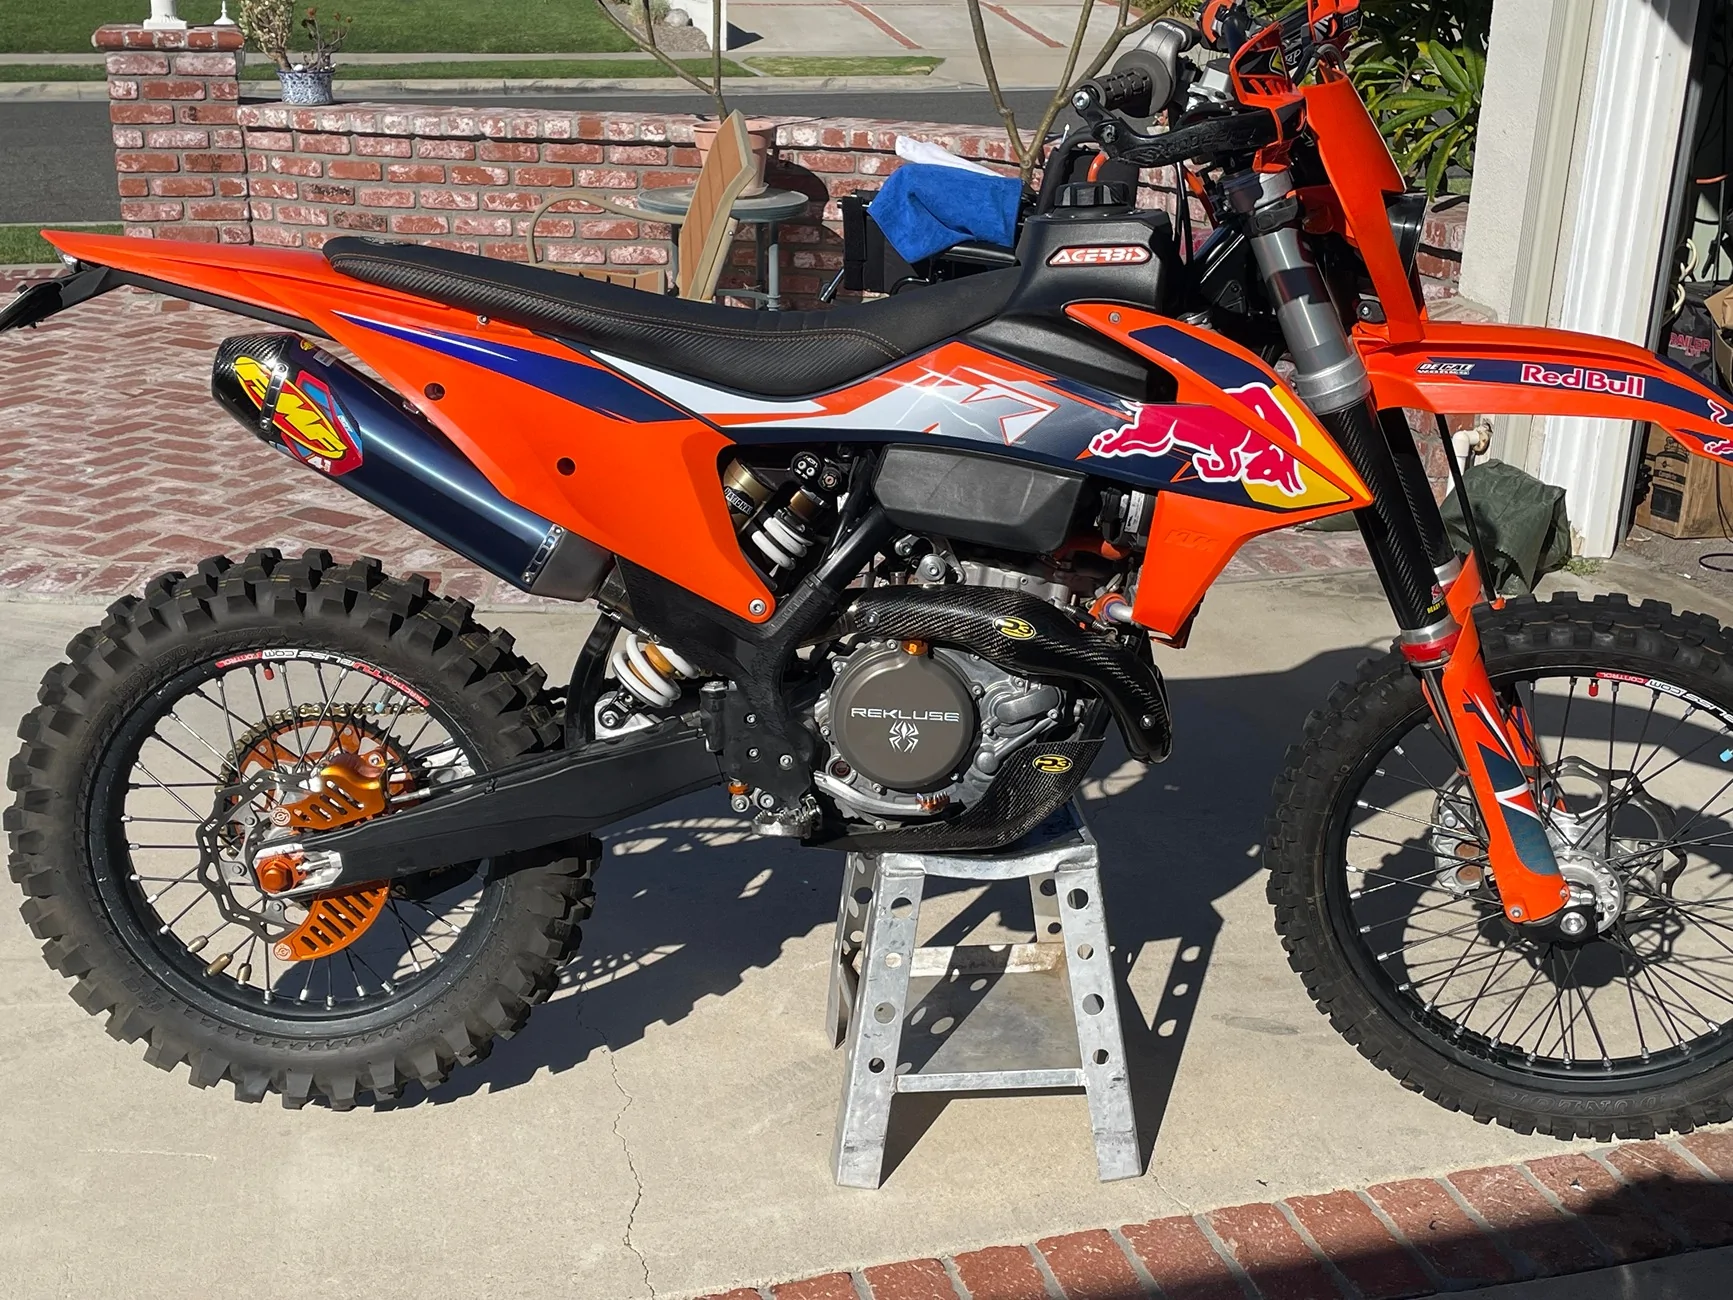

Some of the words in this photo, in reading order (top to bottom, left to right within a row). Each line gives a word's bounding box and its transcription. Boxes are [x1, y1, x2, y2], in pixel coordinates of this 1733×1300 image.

[1051, 247, 1149, 263] ACERBIS
[1520, 363, 1581, 389] Red
[1584, 370, 1646, 398] Bull
[850, 707, 960, 722] REKLUSE
